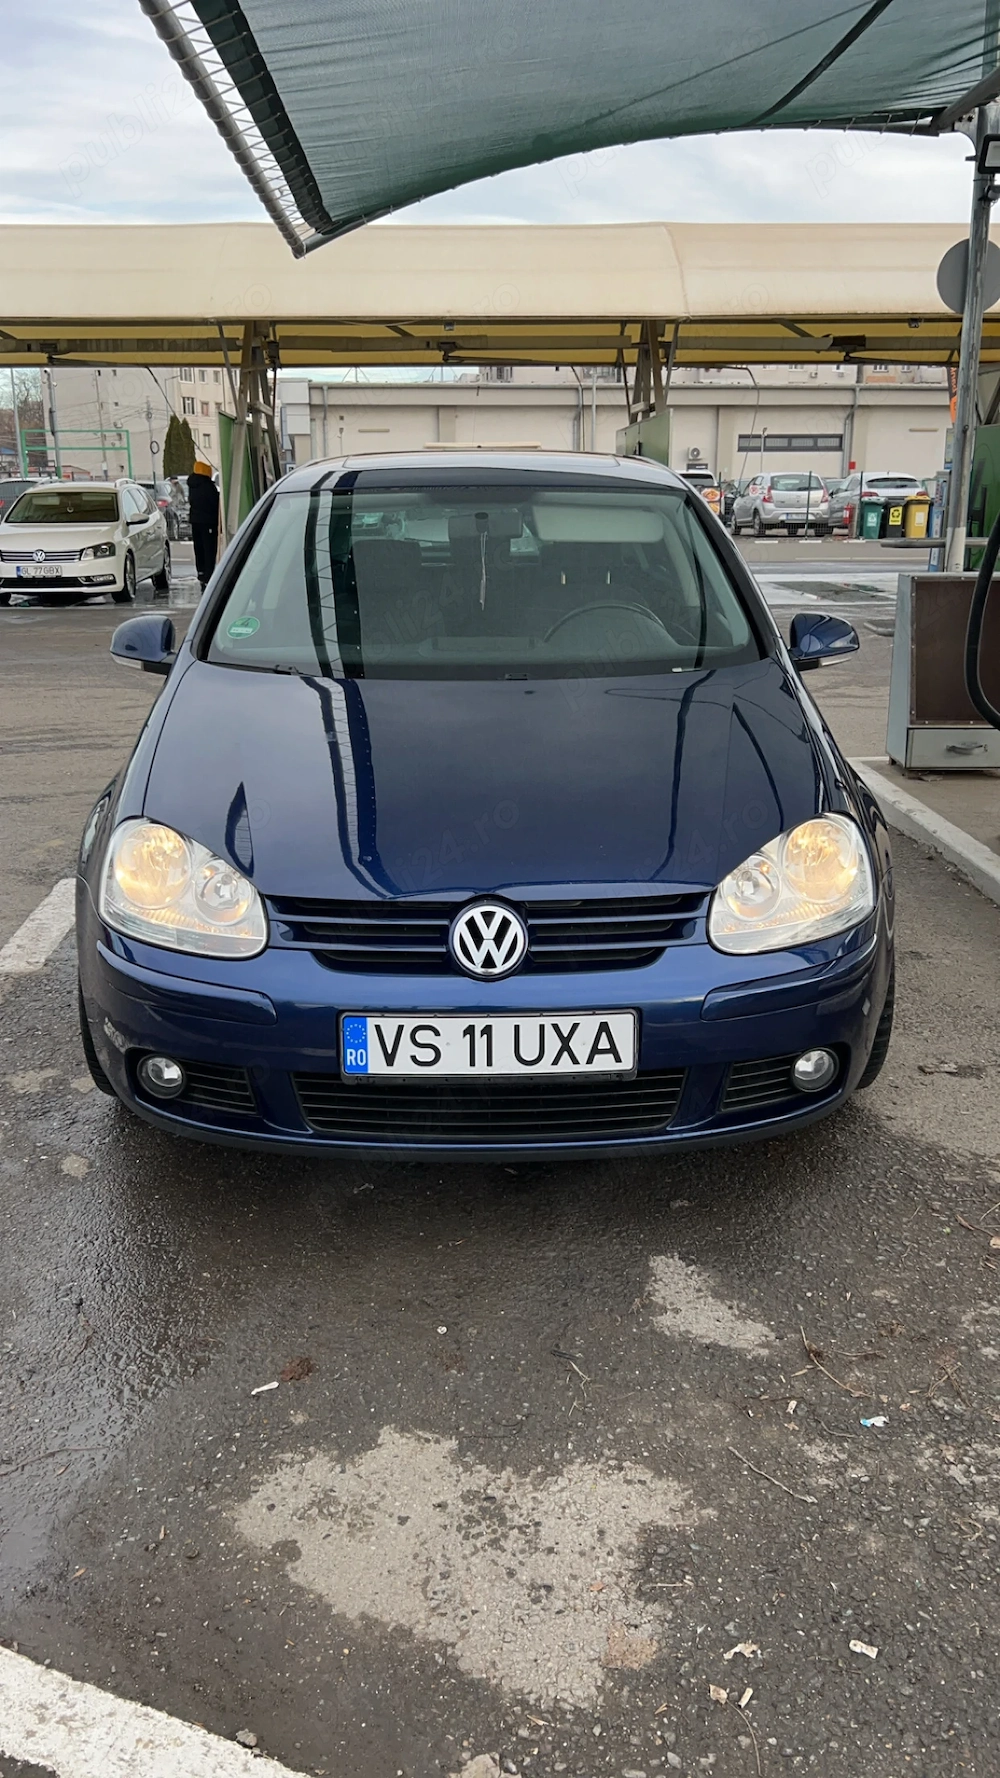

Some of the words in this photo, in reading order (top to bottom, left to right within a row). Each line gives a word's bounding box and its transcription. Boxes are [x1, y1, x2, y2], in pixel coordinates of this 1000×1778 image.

[453, 905, 525, 975] VW
[346, 1048, 366, 1066] RO
[374, 1024, 442, 1067] VS
[462, 1024, 493, 1067] 11
[513, 1021, 623, 1067] UXA
